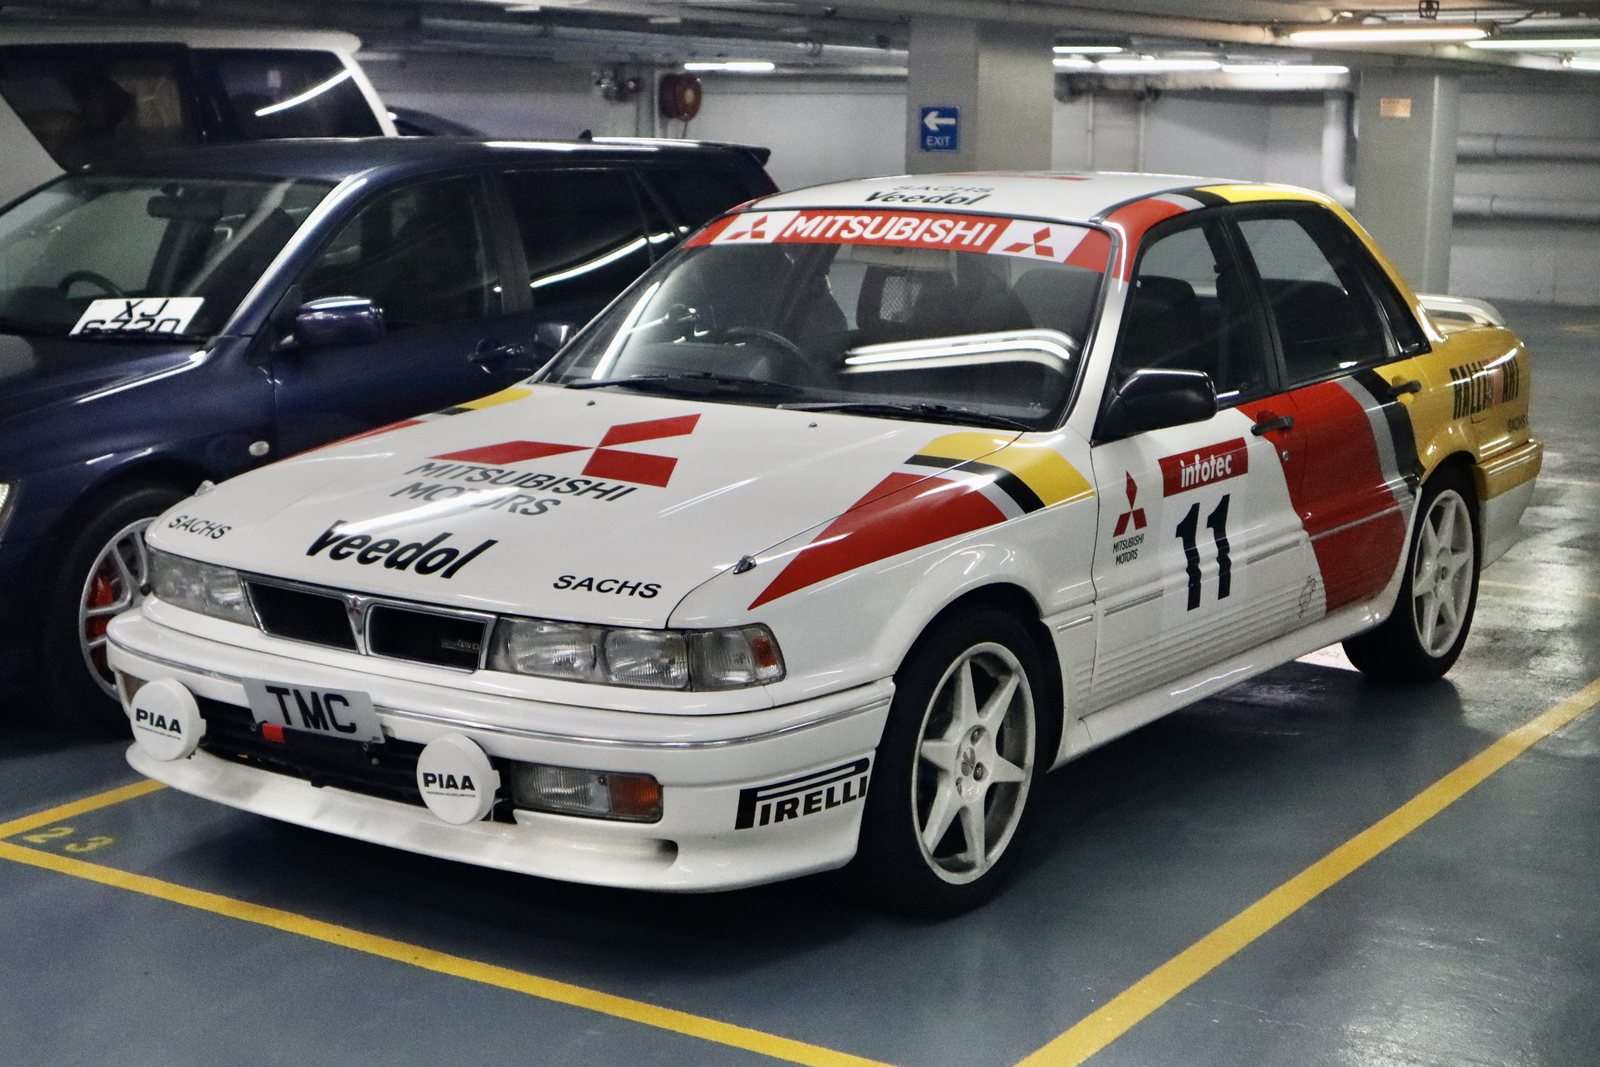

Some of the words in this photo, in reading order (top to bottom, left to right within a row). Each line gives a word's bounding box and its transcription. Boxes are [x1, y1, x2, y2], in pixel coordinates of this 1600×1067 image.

[926, 135, 952, 146] EXIT
[864, 191, 992, 206] Veedol
[782, 214, 998, 247] MITSUBISHI
[114, 299, 170, 319] XJ
[403, 462, 638, 501] MITSUBISHI
[1180, 453, 1233, 489] infotec
[168, 515, 233, 540] SACHS
[305, 519, 500, 580] Veedol
[1113, 533, 1145, 554] MITSUBISHI
[1175, 493, 1232, 612] 11
[1115, 548, 1138, 567] MOTORS
[552, 574, 662, 599] SACHS
[135, 707, 182, 735] PIAA
[265, 685, 357, 734] TMC
[422, 772, 476, 791] PIAA
[734, 757, 870, 830] PIRELLI
[23, 827, 113, 853] 23
